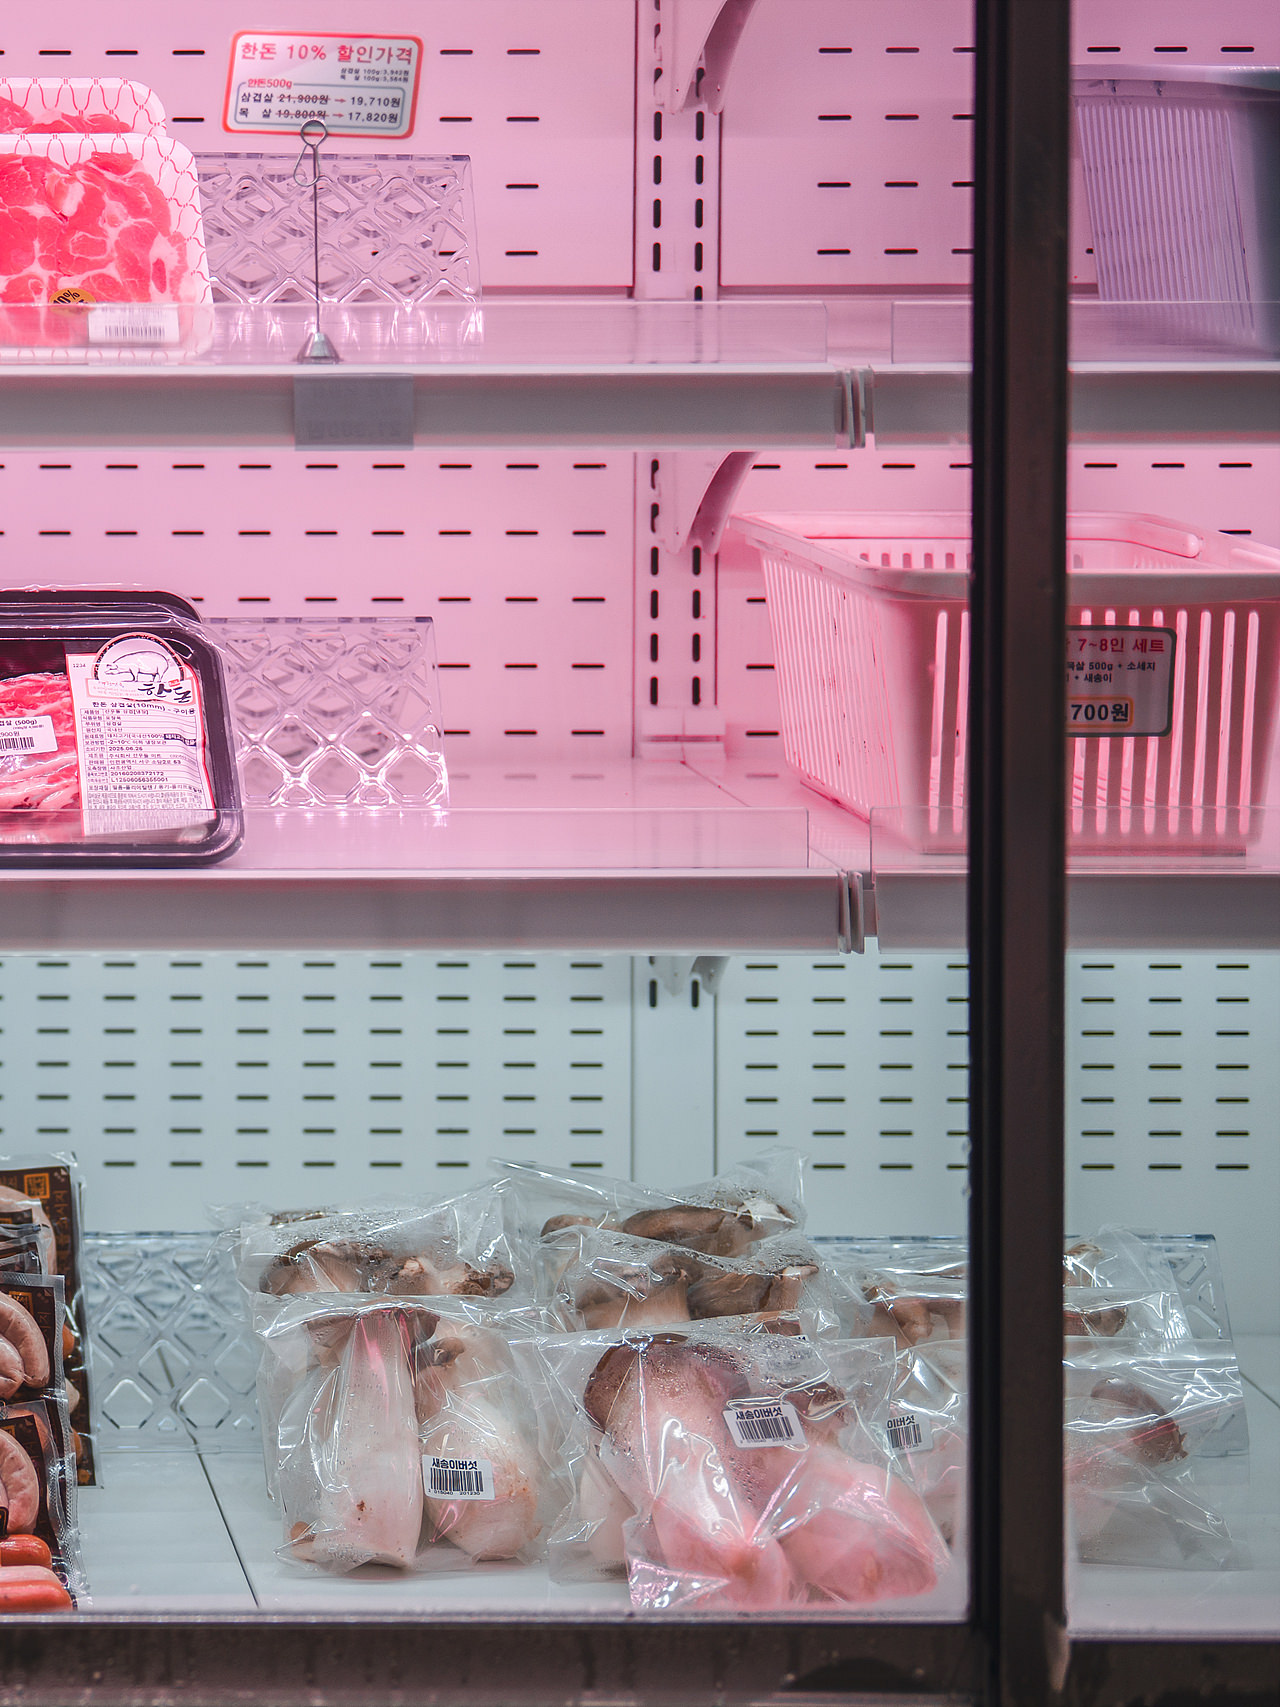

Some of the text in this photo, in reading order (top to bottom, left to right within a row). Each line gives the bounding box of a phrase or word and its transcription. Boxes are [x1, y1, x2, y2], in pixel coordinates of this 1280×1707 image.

[241, 42, 413, 65] 한돈 10% 할인가격
[240, 92, 274, 104] 삼겹살
[1078, 638, 1165, 654] 7~8인 세트
[1088, 662, 1114, 672] 500g
[1126, 662, 1156, 672] 소세지
[1084, 673, 1112, 683] 새송이
[1071, 703, 1129, 722] 700원
[735, 1406, 782, 1420] 새송이버섯
[886, 1416, 916, 1429] 이버섯
[432, 1458, 478, 1470] 새송이버섯
